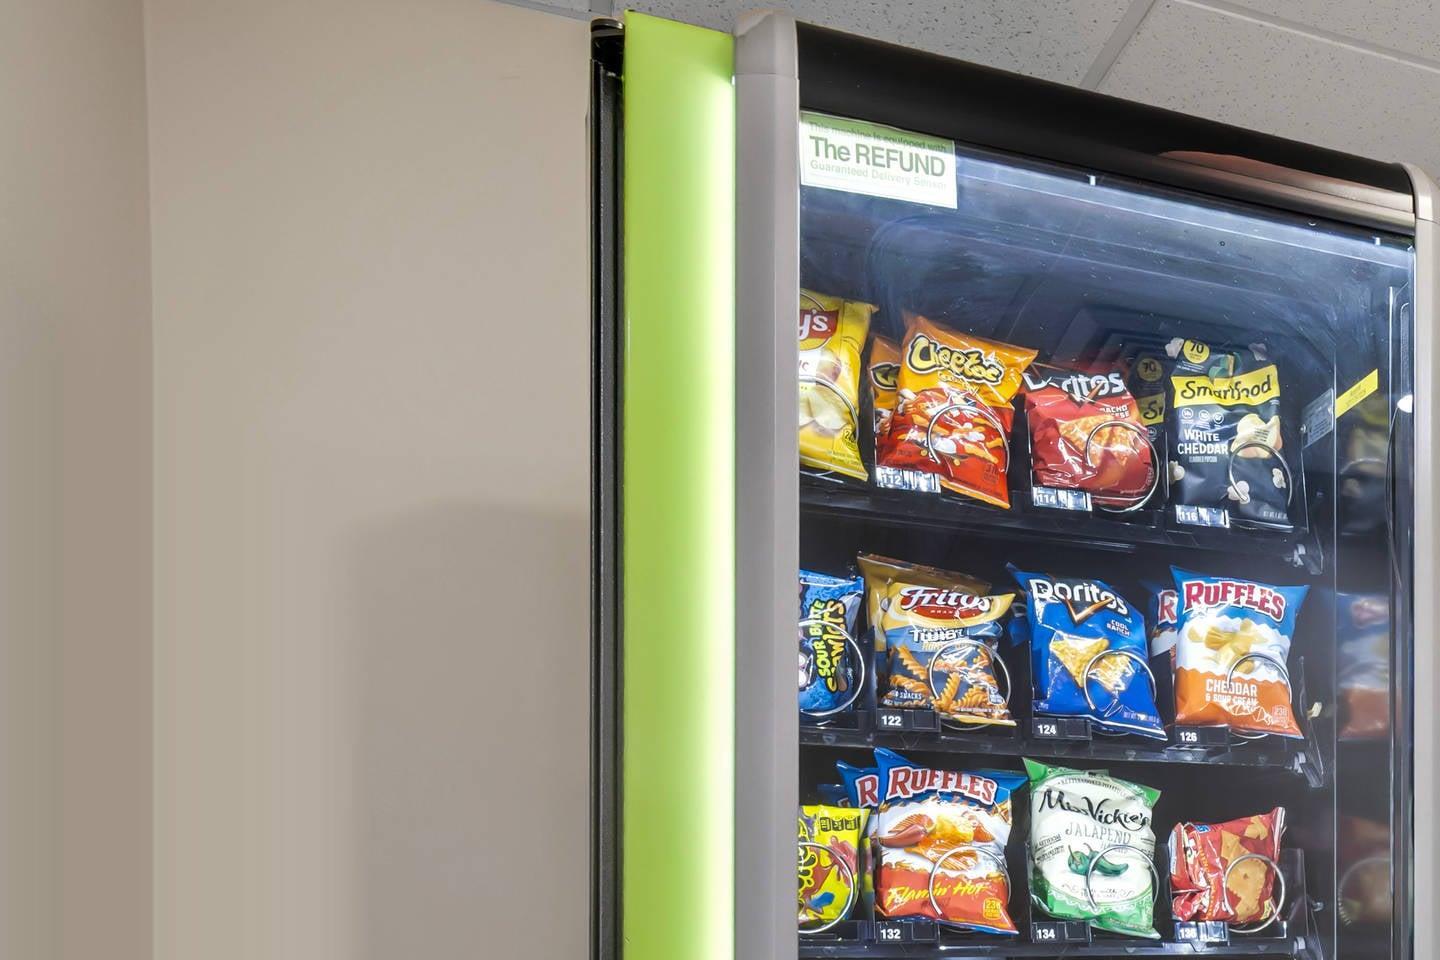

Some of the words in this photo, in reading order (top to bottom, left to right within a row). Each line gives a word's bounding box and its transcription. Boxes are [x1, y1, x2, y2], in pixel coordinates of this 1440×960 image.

[809, 135, 850, 162] The
[855, 143, 946, 177] REFUND
[1180, 374, 1273, 403] Smartfood
[1184, 428, 1221, 443] WHITE
[1177, 443, 1229, 456] CHEDDAR
[882, 472, 902, 486] 112
[1038, 493, 1056, 505] 114
[1179, 511, 1197, 523] 116
[899, 588, 992, 612] Fritos
[1028, 578, 1129, 616] Doritos
[1183, 580, 1286, 622] RUFFLES
[815, 642, 831, 678] SOUR
[881, 715, 902, 727] 122
[1037, 724, 1056, 735] 124
[1180, 731, 1198, 742] 126
[887, 765, 998, 805] RUFFLES
[1038, 787, 1090, 817] Miss
[1082, 796, 1152, 832] Vickie's
[953, 880, 988, 897] Hot
[881, 928, 901, 939] 132
[1036, 929, 1055, 939] 134
